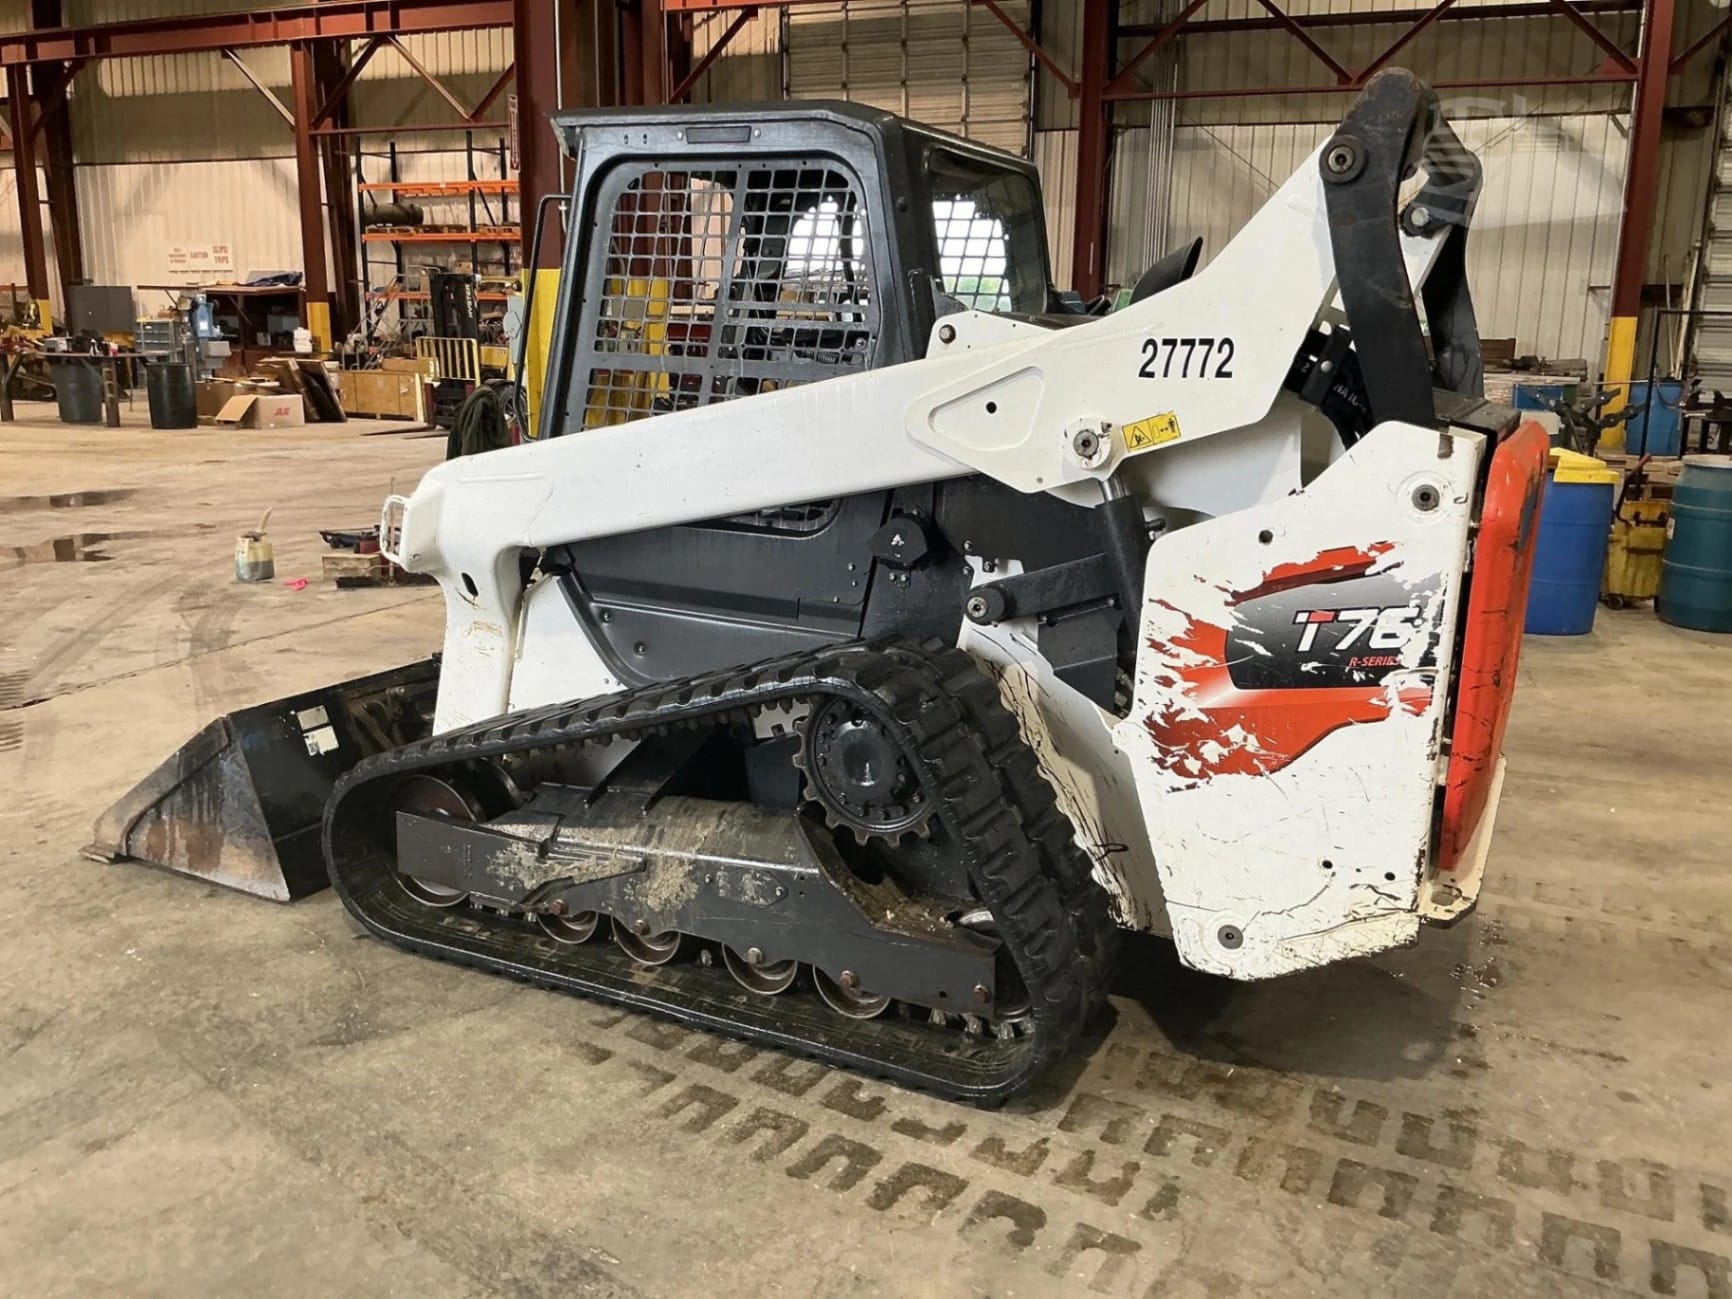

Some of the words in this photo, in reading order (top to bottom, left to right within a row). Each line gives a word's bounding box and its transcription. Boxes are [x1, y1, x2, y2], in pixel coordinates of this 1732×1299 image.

[464, 283, 474, 318] HYSTER
[1138, 337, 1235, 379] 27772
[1293, 606, 1421, 652] T76
